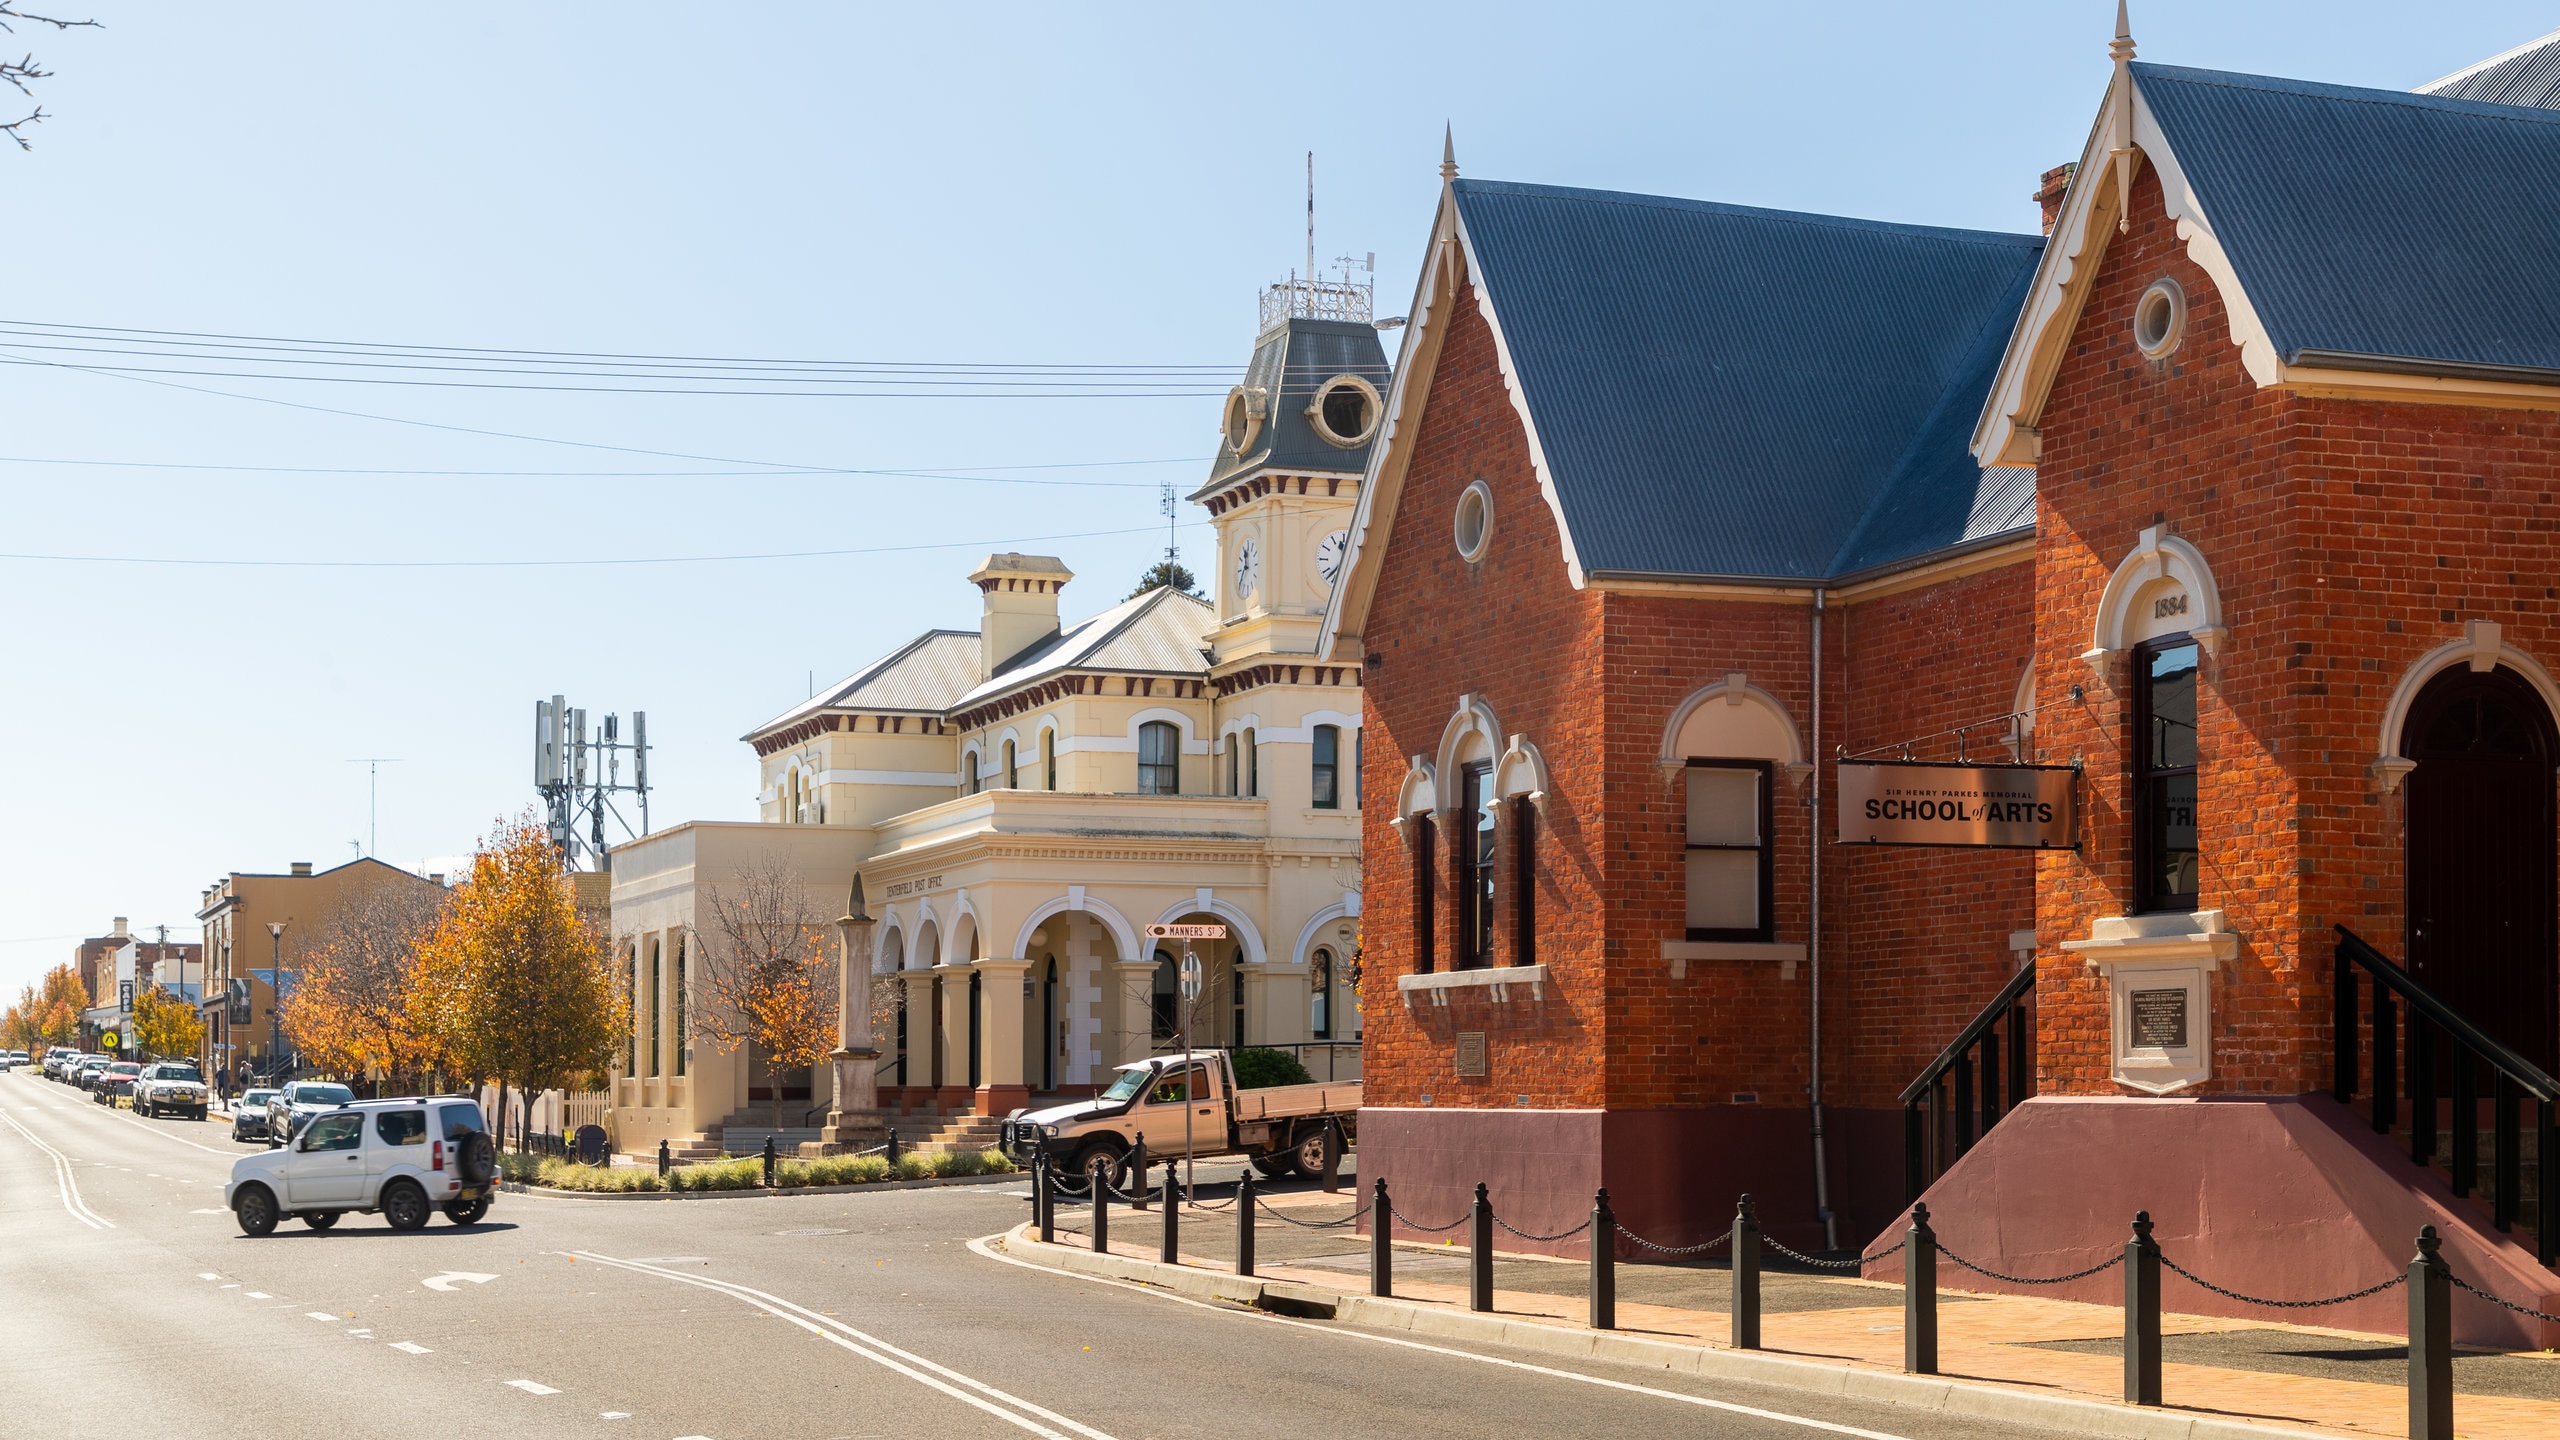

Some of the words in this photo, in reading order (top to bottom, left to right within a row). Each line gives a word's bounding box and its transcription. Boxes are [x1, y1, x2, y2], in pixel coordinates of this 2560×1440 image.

[2154, 594, 2188, 619] 1884
[1885, 788, 1902, 796] SIR
[1906, 789, 1937, 797] HENRY
[1942, 790, 1978, 798] PARKES
[1983, 791, 2032, 799] MEMORIAL
[1865, 798, 1971, 822] SCHOOL
[1972, 803, 1987, 821] of
[1986, 802, 2053, 823] ARTS
[886, 881, 912, 898] TENTERFIELD
[914, 878, 925, 892] POST
[928, 875, 943, 889] OFFICE
[1169, 926, 1203, 937] MANNERS
